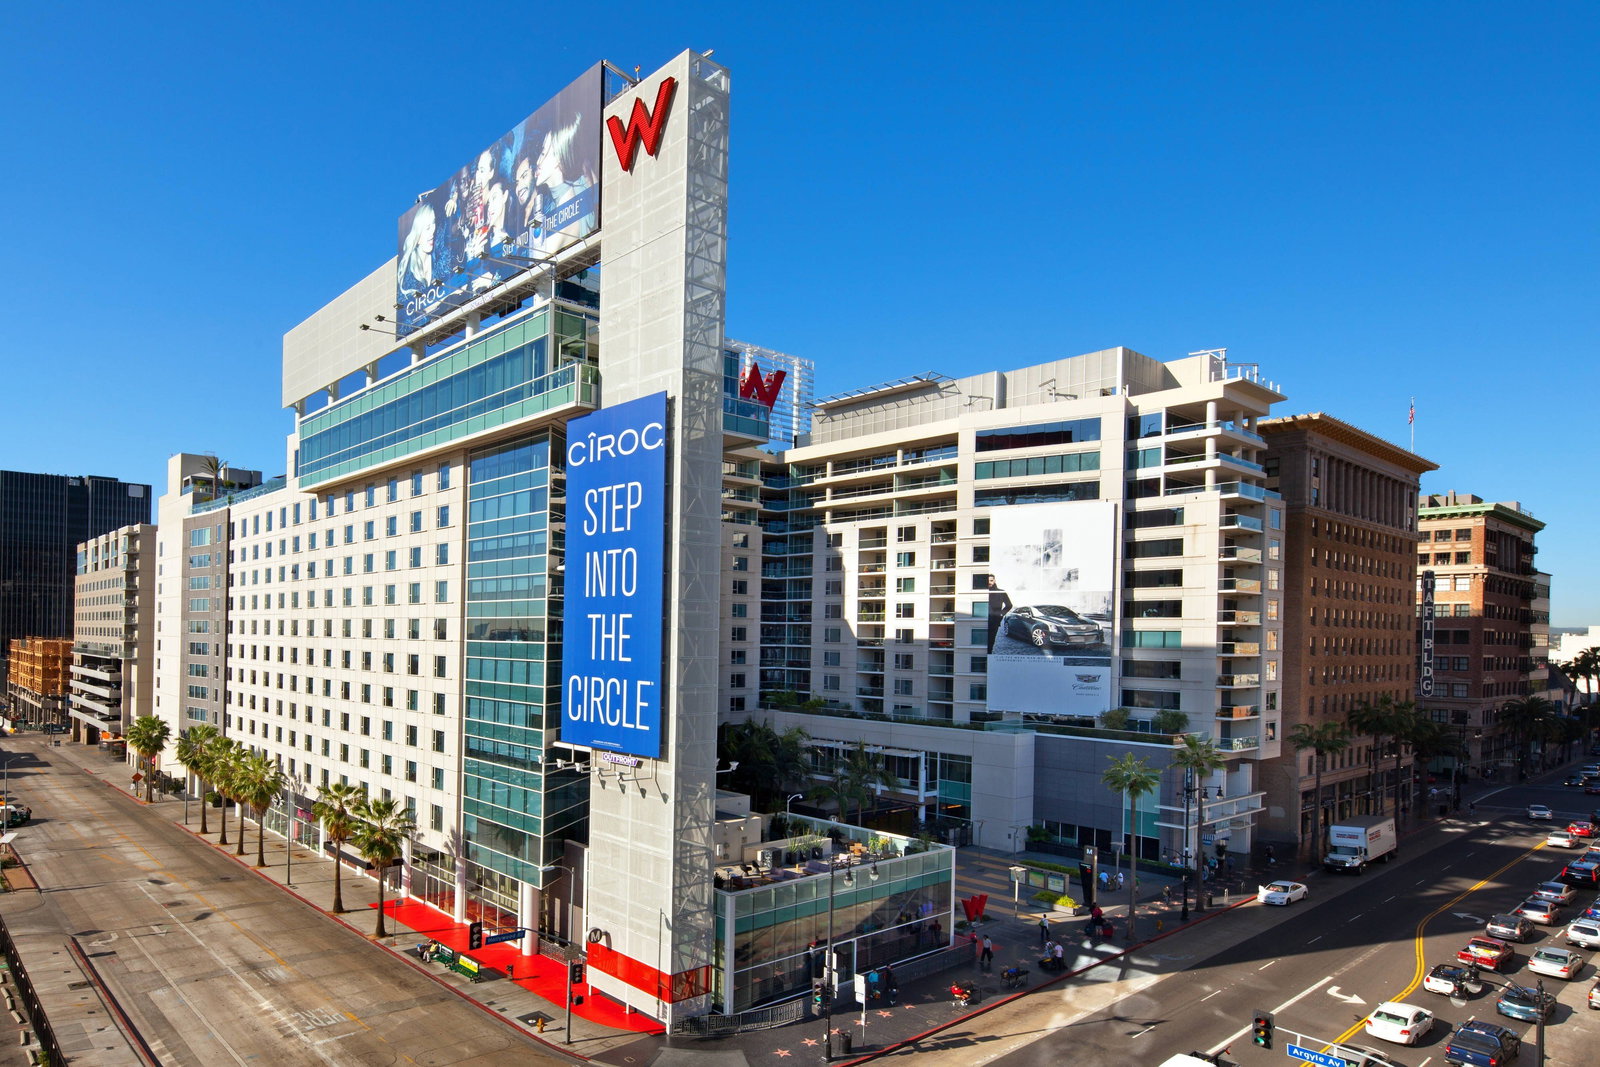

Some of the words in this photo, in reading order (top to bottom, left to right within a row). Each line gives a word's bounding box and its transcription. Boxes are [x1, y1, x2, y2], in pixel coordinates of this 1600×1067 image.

[606, 76, 675, 172] W
[546, 213, 558, 230] THE
[558, 199, 580, 224] CIRCLE
[740, 362, 787, 412] W
[584, 481, 642, 536] STEP
[585, 547, 637, 598] INTO
[1424, 578, 1434, 631] TAFT
[588, 613, 632, 662] THE
[1423, 638, 1433, 691] BLDG
[568, 675, 652, 730] CIRCLE
[961, 893, 988, 922] W
[590, 930, 601, 942] M
[1292, 1047, 1325, 1063] Argyle
[1328, 1058, 1341, 1067] Av
